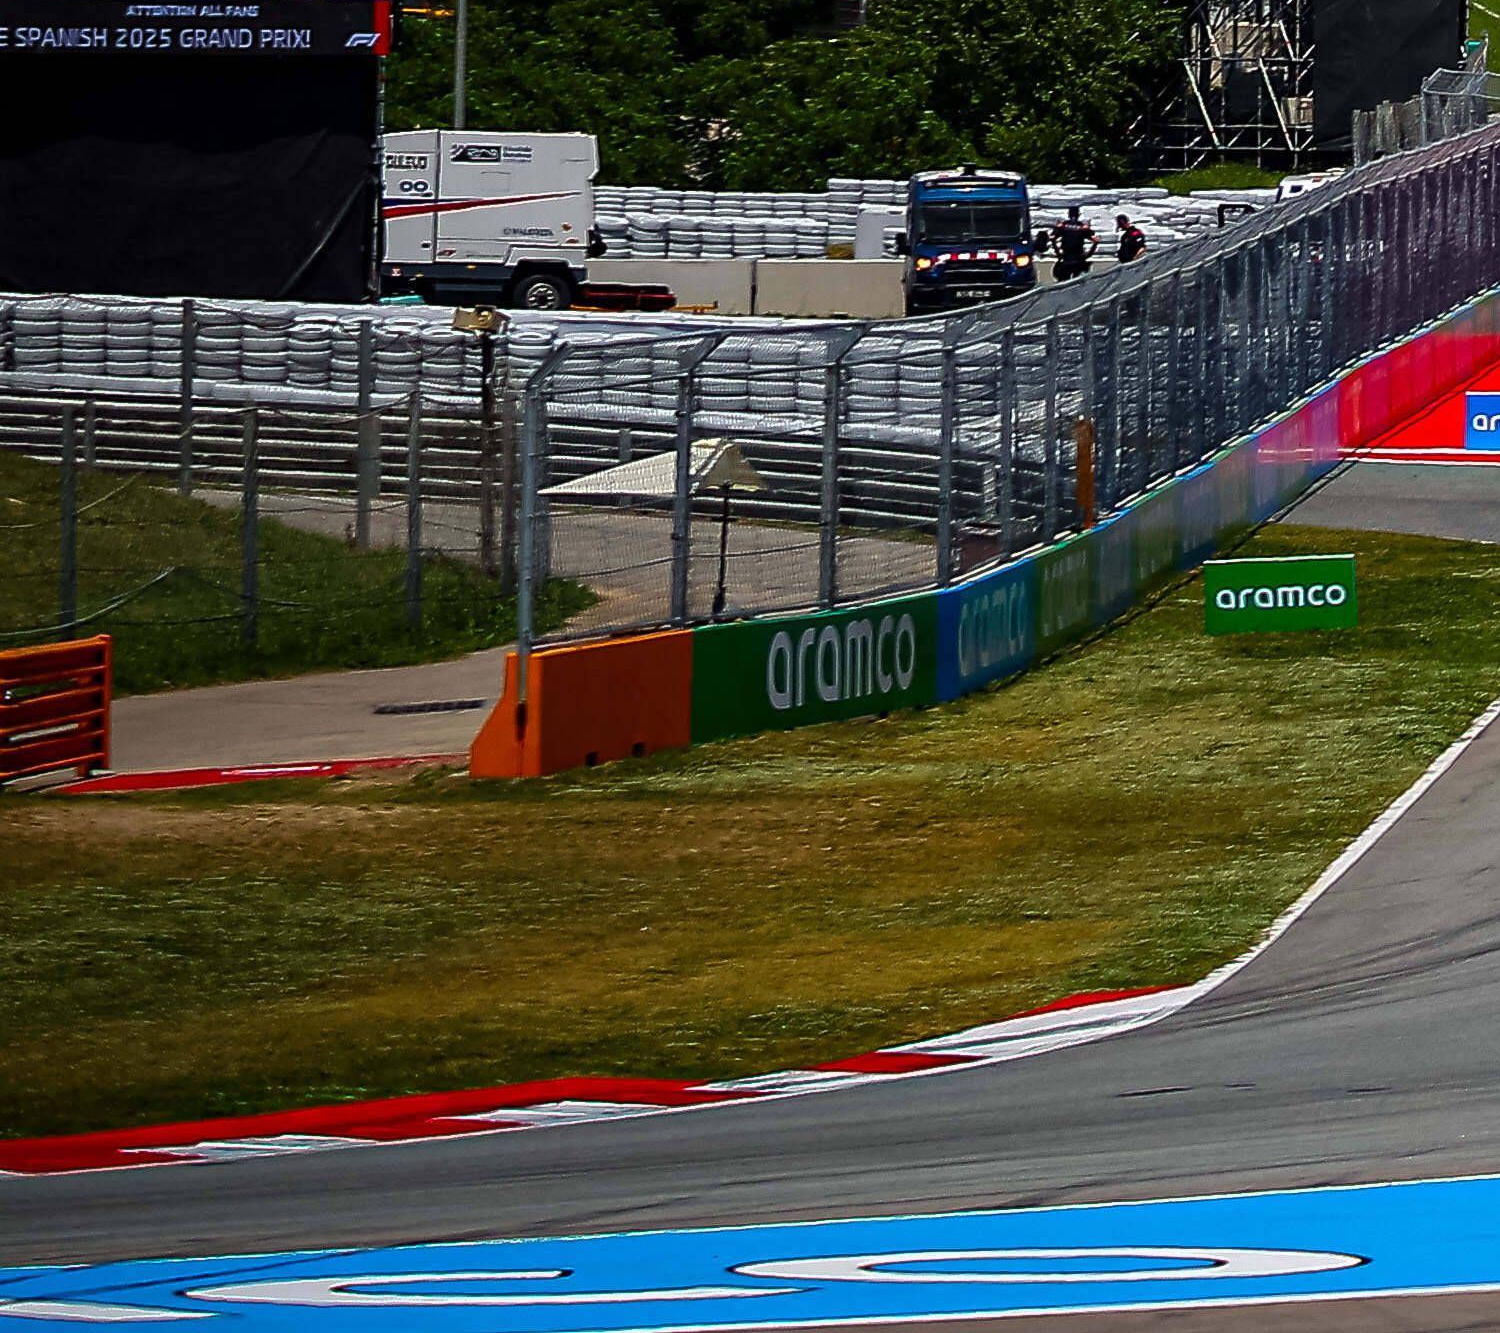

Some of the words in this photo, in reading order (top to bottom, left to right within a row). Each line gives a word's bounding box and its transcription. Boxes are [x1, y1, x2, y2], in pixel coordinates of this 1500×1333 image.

[15, 27, 107, 48] SPANISH
[115, 28, 172, 48] 2025
[180, 28, 253, 48] GRAND
[260, 28, 311, 49] PRIX!
[1216, 585, 1346, 609] aramco
[767, 613, 916, 711] aramco
